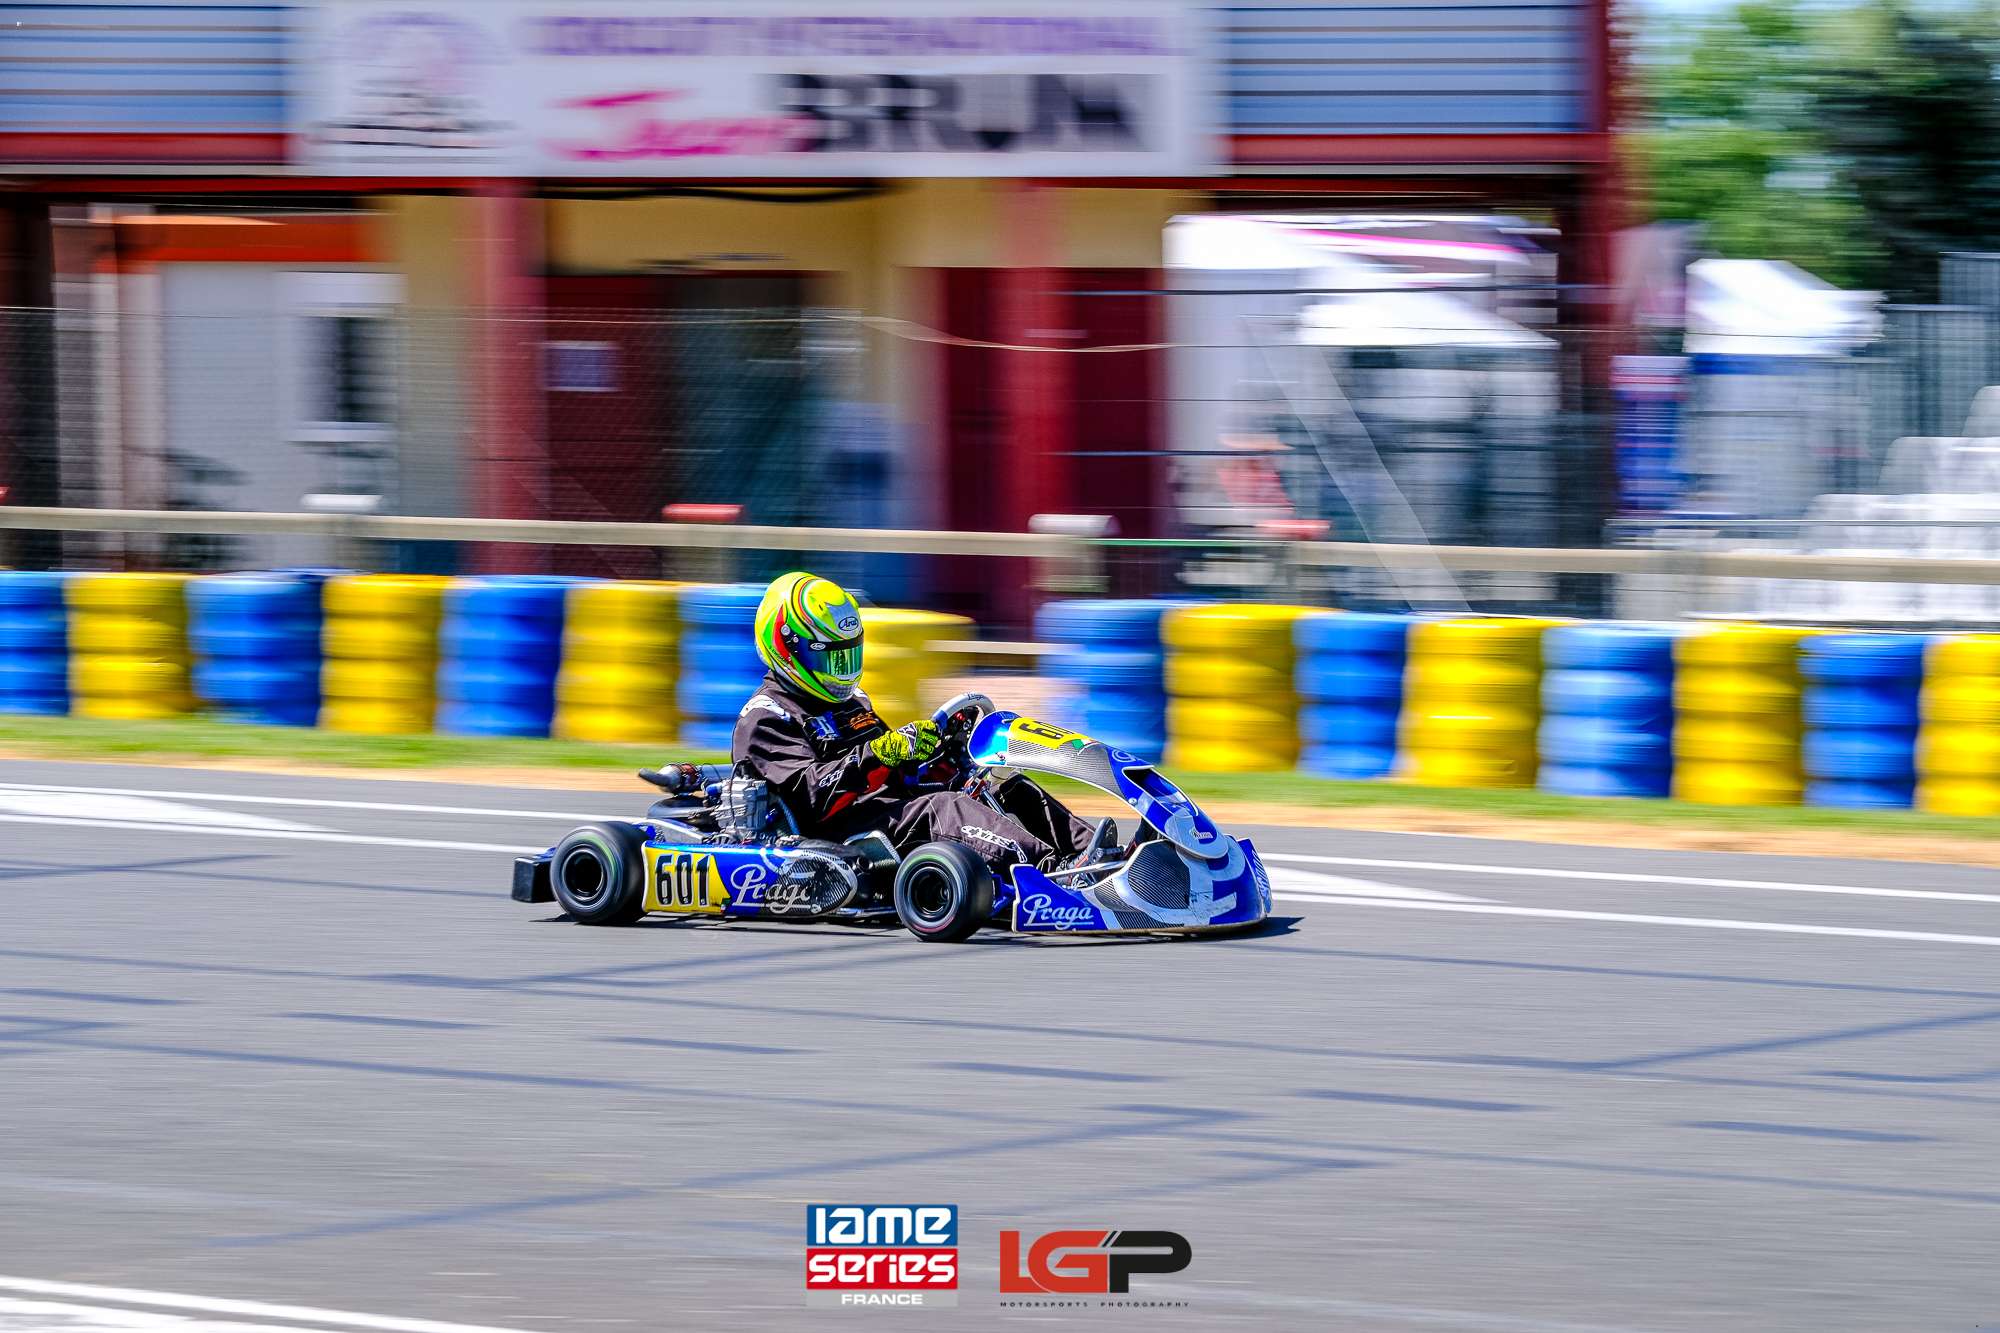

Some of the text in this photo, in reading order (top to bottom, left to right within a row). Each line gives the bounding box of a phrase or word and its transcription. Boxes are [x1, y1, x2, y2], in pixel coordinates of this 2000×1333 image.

[775, 73, 1160, 153] BRUN
[656, 854, 712, 906] 601
[1023, 894, 1094, 930] Praga
